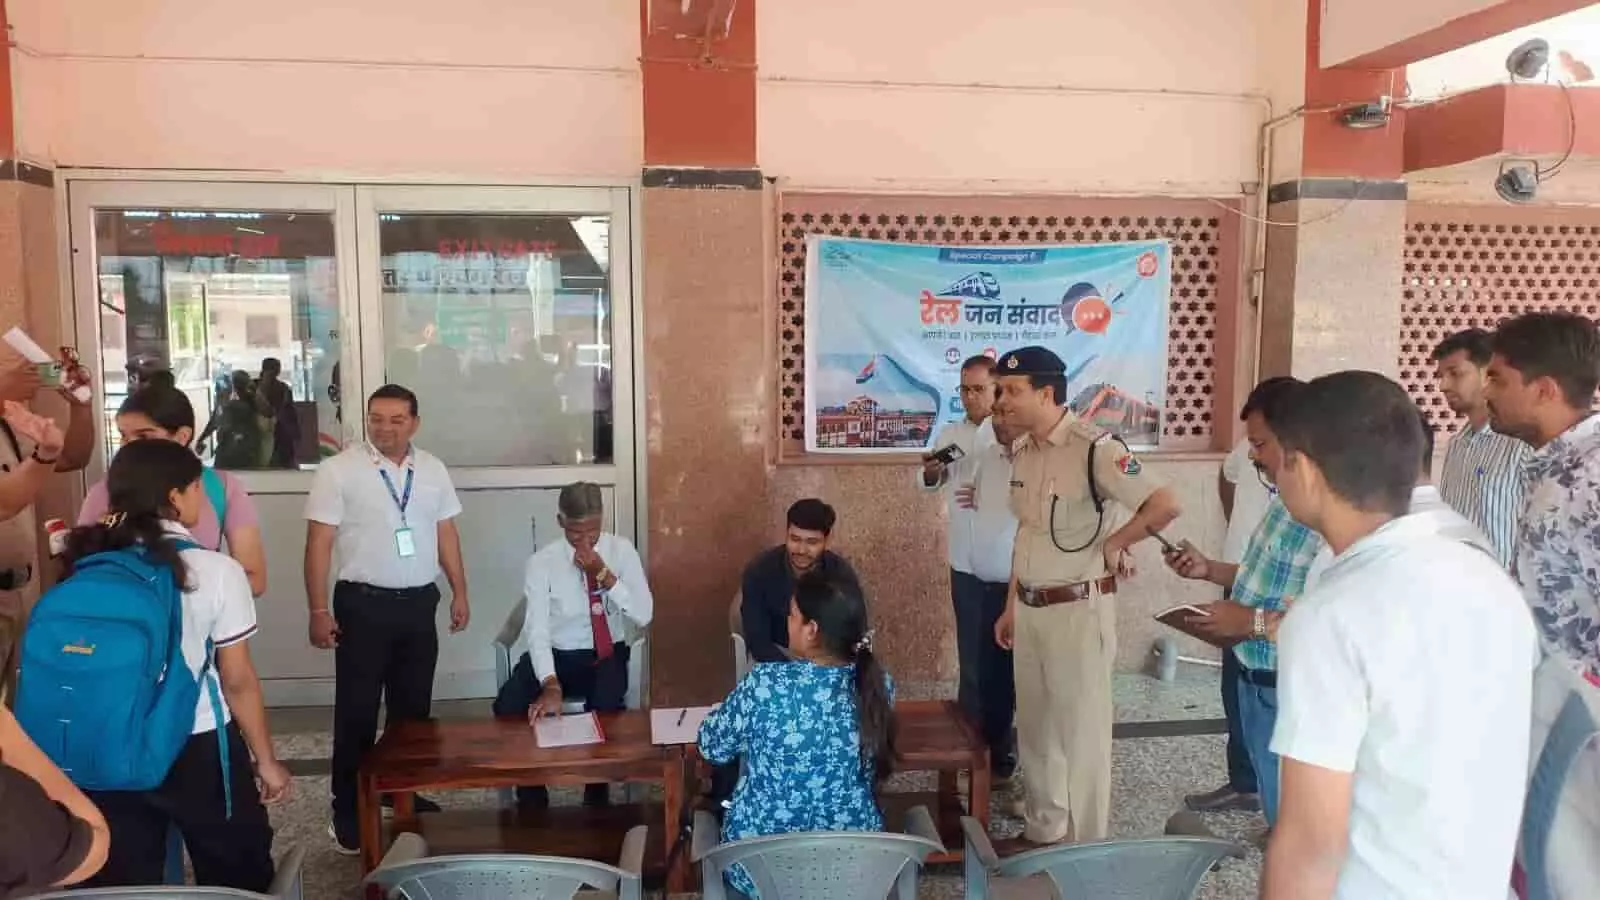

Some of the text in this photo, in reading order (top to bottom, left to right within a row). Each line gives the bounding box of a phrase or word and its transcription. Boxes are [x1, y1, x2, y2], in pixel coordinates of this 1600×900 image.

[919, 289, 1063, 325] रेल जन संवाद
